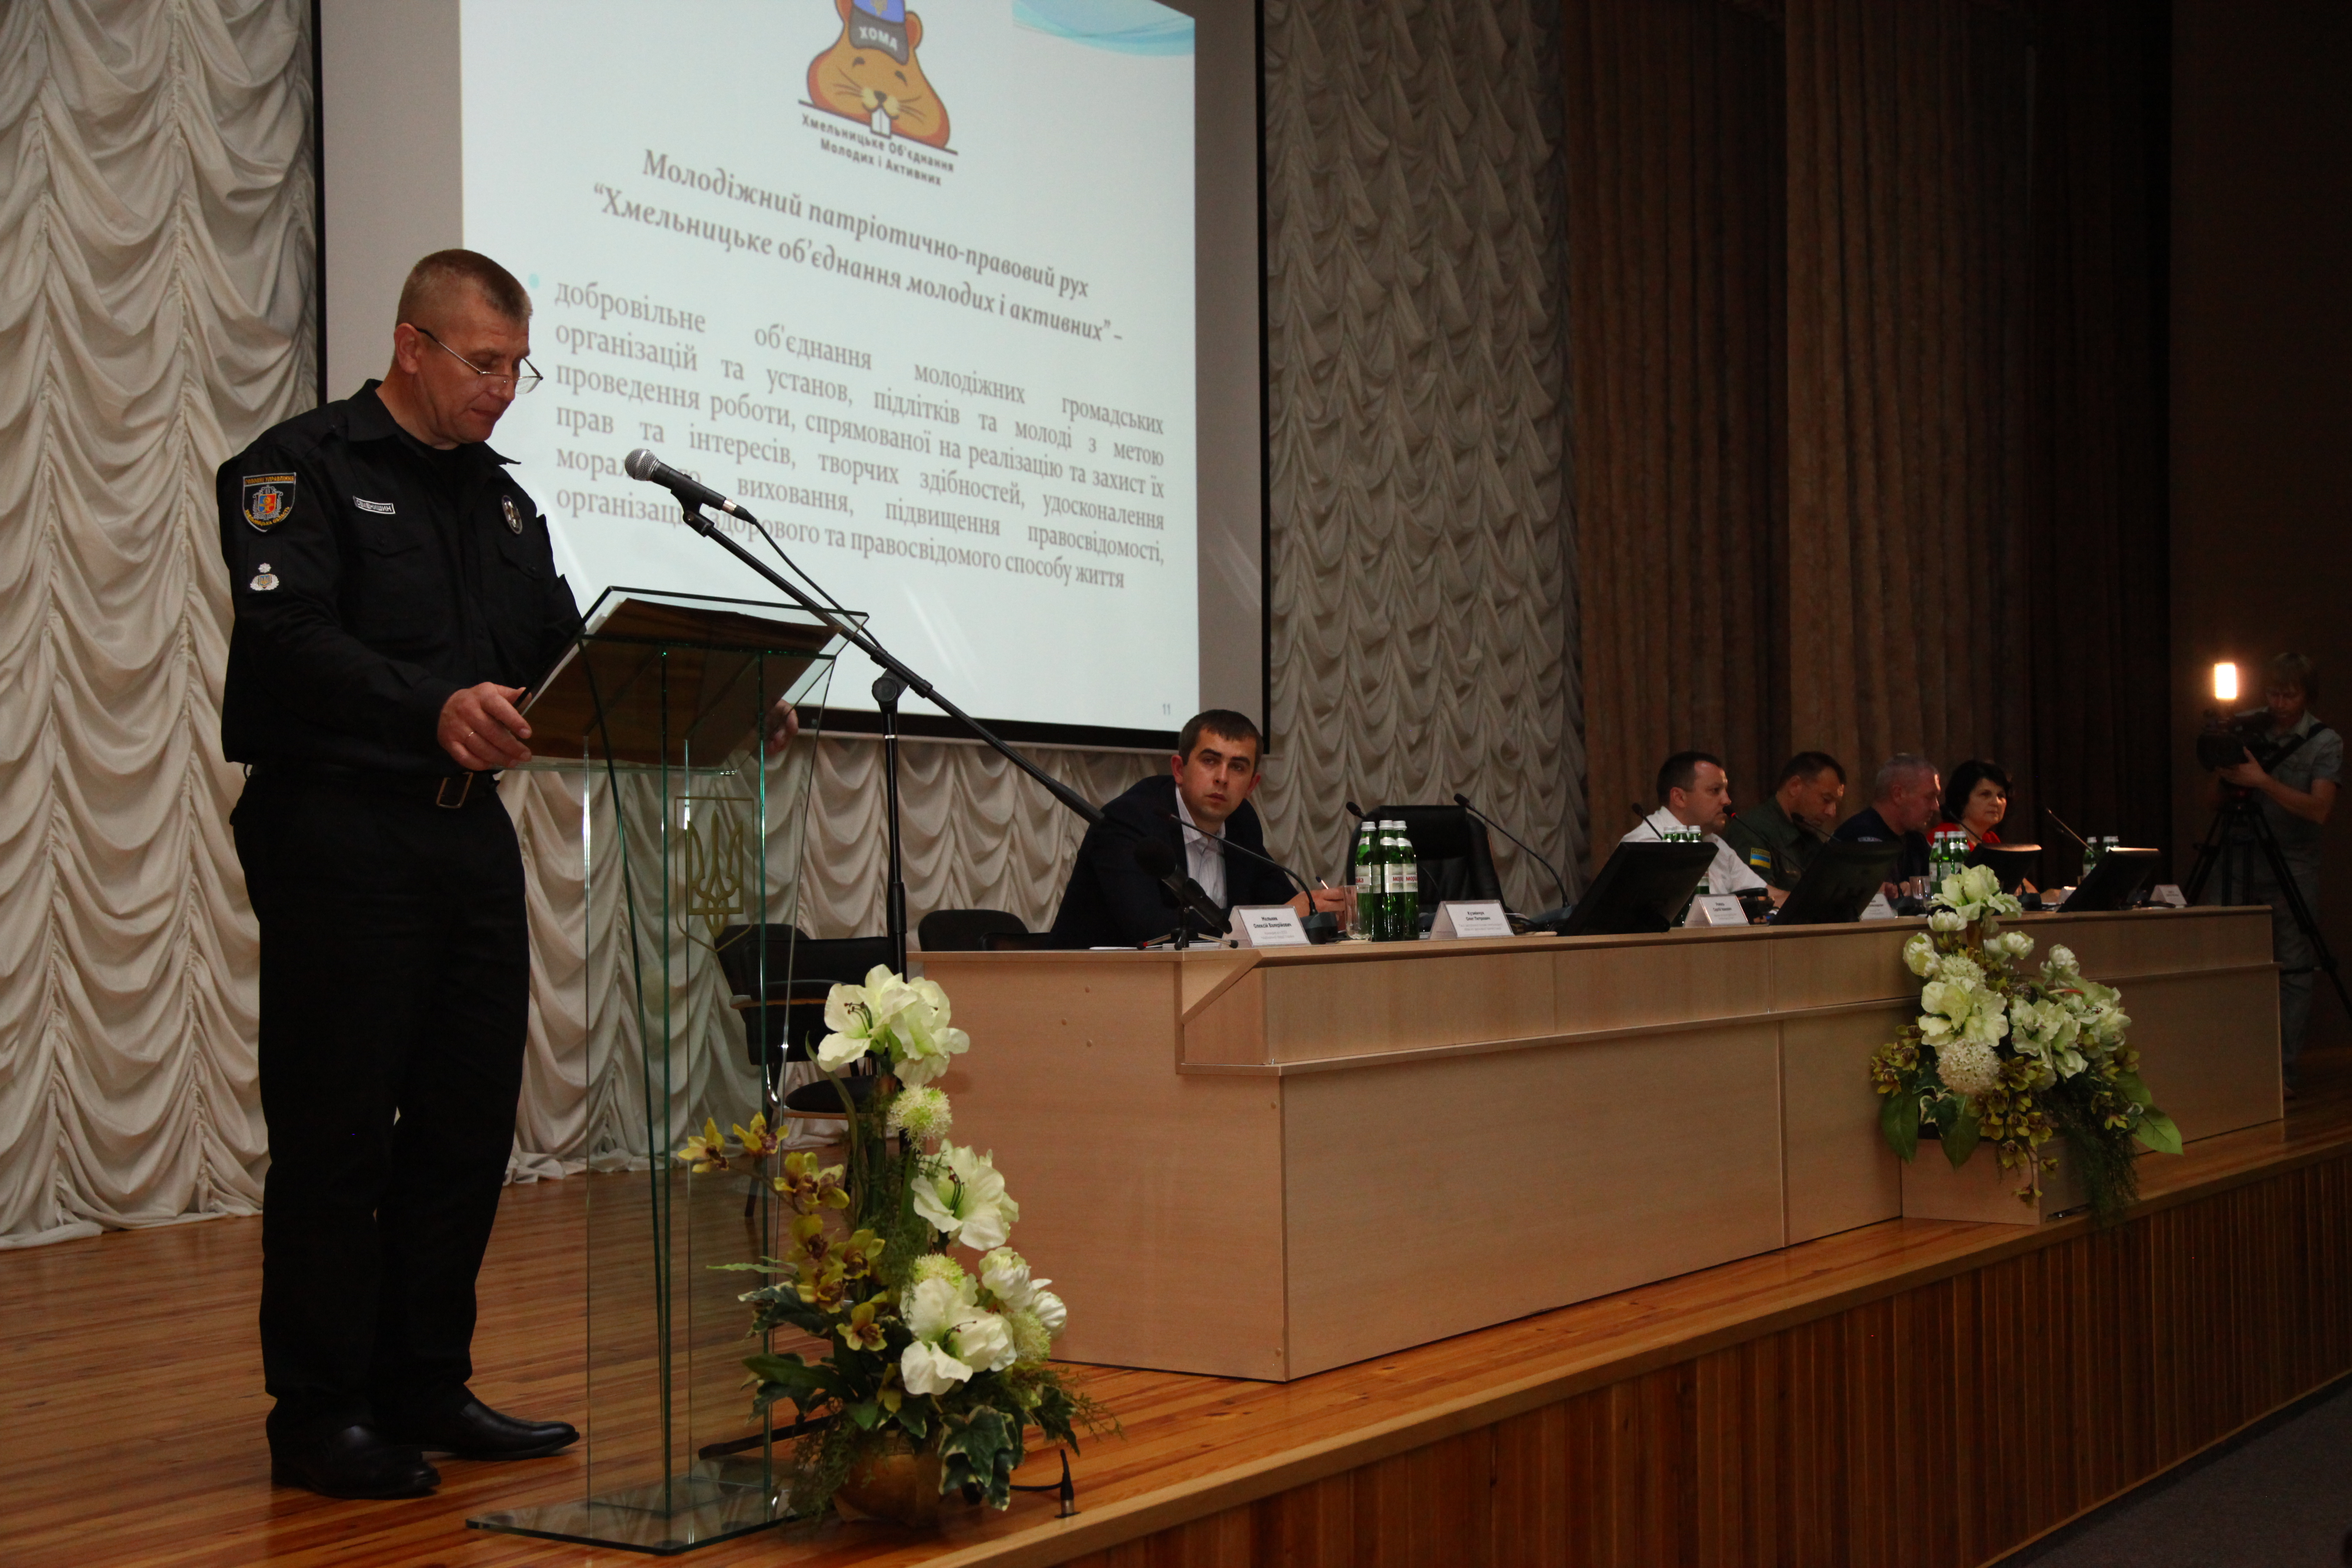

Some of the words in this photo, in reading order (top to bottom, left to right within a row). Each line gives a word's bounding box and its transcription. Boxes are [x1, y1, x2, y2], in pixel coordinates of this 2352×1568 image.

[859, 26, 898, 51] ХОМА
[802, 113, 885, 151] Хмельницьке
[820, 138, 874, 165] Молодих
[878, 156, 882, 168] і
[885, 159, 941, 186] Активних
[642, 149, 802, 218] Молодіжний
[809, 204, 1055, 288] патріотично-правовий
[1058, 275, 1088, 301] рух
[905, 276, 995, 313] молодих
[999, 294, 1005, 316] і
[554, 281, 705, 333] добровільне
[755, 323, 871, 370] об'єднання
[915, 364, 1025, 404] молодіжних
[1062, 397, 1163, 435] громадських
[556, 325, 697, 371] організацій
[721, 359, 744, 381] та
[766, 369, 852, 407] установ,
[874, 387, 960, 425] підлітків
[978, 414, 997, 432] та
[1015, 421, 1072, 450] молоді
[1088, 437, 1096, 453] з
[1114, 442, 1164, 466] метою
[557, 365, 699, 410] проведення
[710, 393, 795, 432] роботи,
[805, 415, 931, 454] спрямованої
[939, 440, 961, 459] на
[969, 446, 1063, 478] реалізацію
[1069, 465, 1086, 484] та
[1092, 470, 1146, 494] захист
[1151, 475, 1164, 498] їх
[557, 407, 614, 437] прав
[640, 422, 664, 443] та
[690, 423, 796, 469] інтересів,
[818, 454, 899, 485] творчих
[920, 469, 1025, 509] здібностей,
[1043, 494, 1164, 530] удосконалення
[273, 507, 290, 523] ОБЛАСТЬ
[738, 478, 854, 517] виховання,
[886, 498, 1000, 536] підвищення
[1028, 526, 1164, 565] правосвідомості,
[825, 529, 846, 548] та
[851, 532, 1001, 570] правосвідомого
[1005, 555, 1072, 587] способу
[1075, 566, 1124, 588] життя
[1163, 704, 1170, 714] 11
